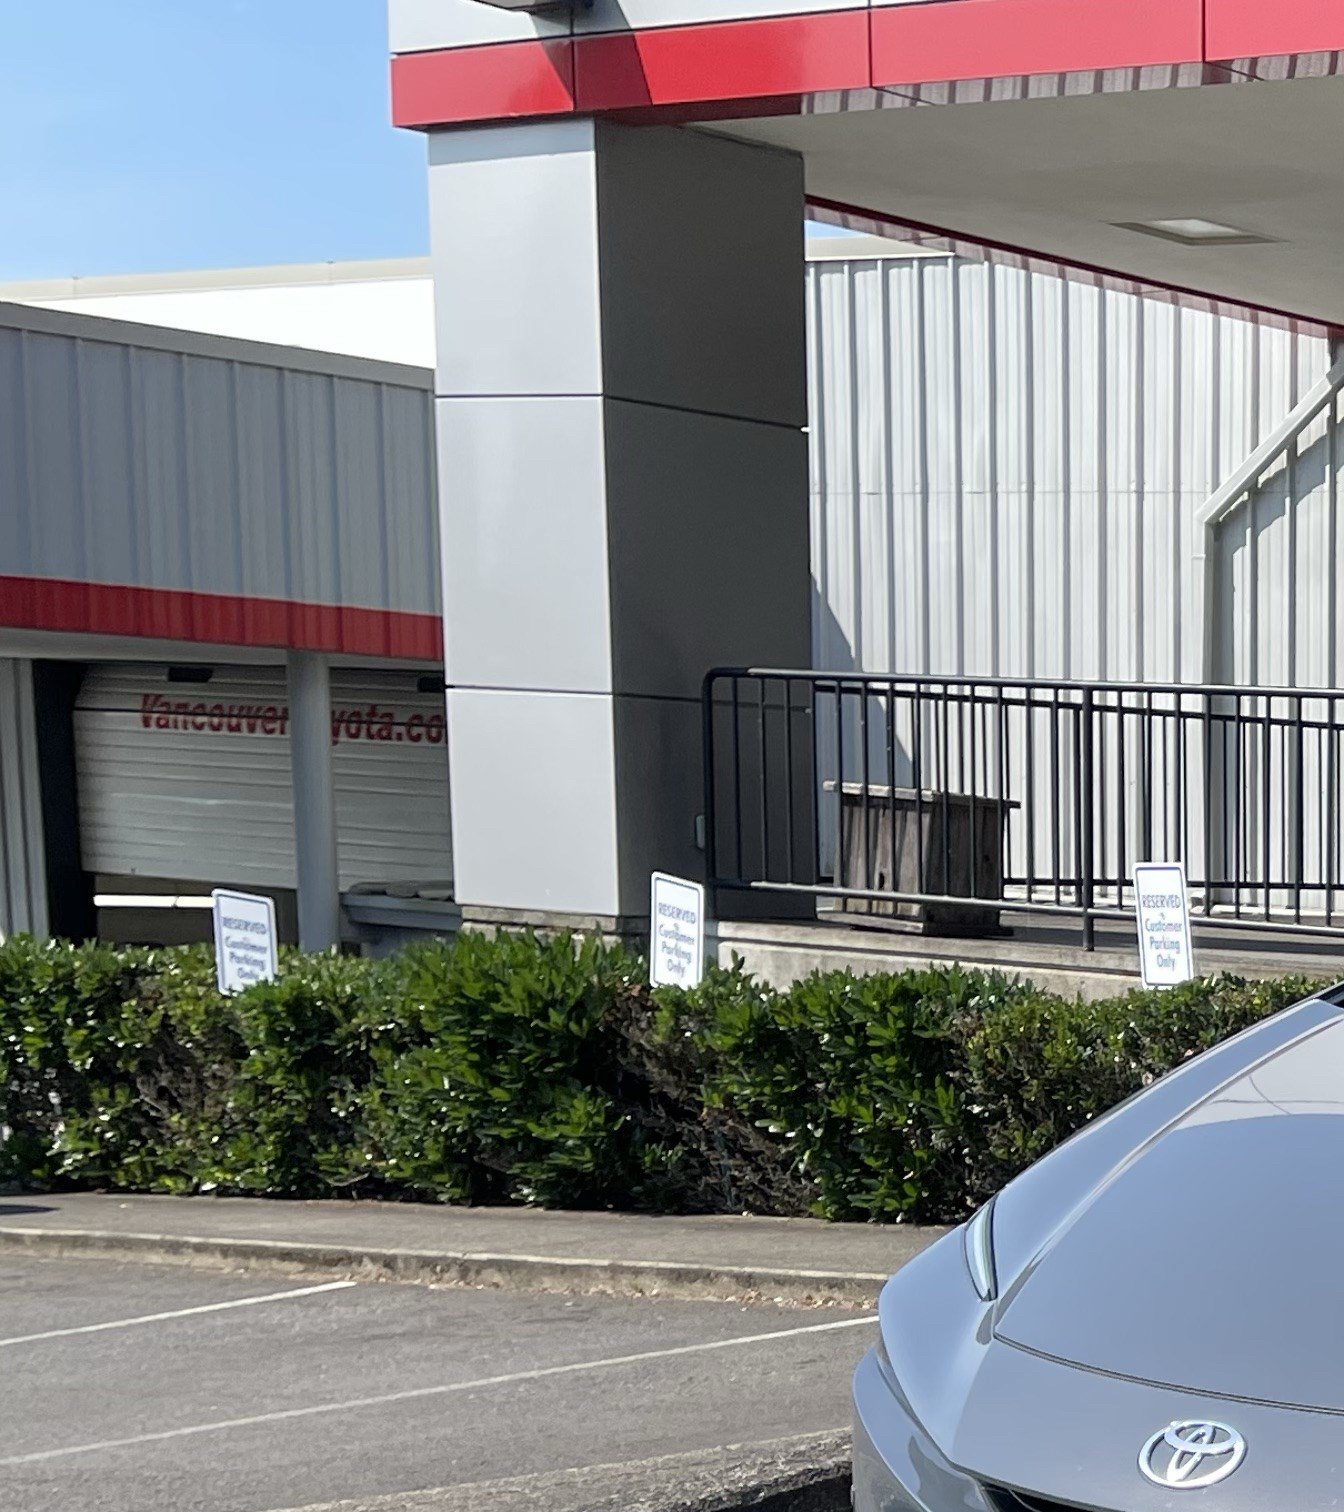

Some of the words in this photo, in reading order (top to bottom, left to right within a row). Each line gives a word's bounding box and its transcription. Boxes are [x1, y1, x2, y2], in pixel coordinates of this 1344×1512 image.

[1142, 893, 1181, 909] RESERVED
[658, 902, 697, 925] RESERVED
[658, 923, 695, 945] Customer
[1144, 918, 1183, 933] Customer
[661, 940, 692, 966] Parking
[1149, 936, 1181, 955] Parking
[1156, 953, 1176, 972] Only
